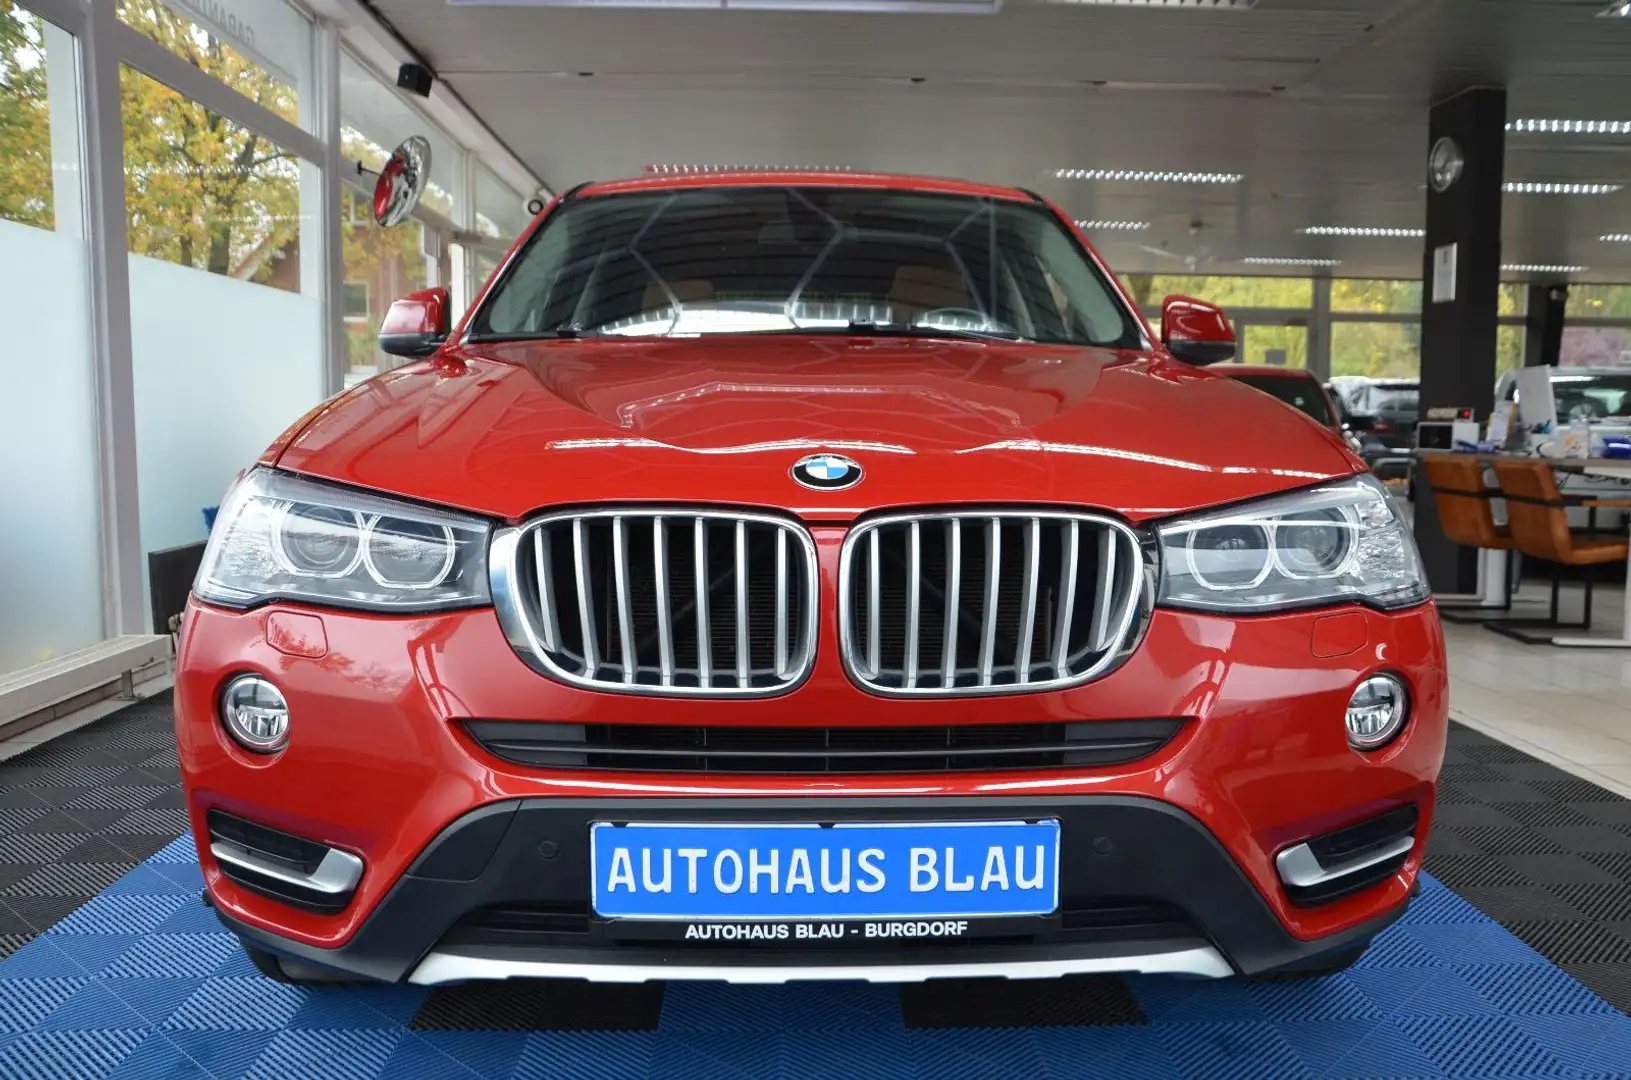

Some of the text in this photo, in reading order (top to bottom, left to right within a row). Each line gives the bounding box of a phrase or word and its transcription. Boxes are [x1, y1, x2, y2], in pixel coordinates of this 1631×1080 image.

[607, 845, 1045, 894] AUTOHAUS BLAU
[685, 923, 789, 940] AUTOHAUS
[795, 923, 844, 939] BLAU
[865, 921, 968, 938] BURGDORF
